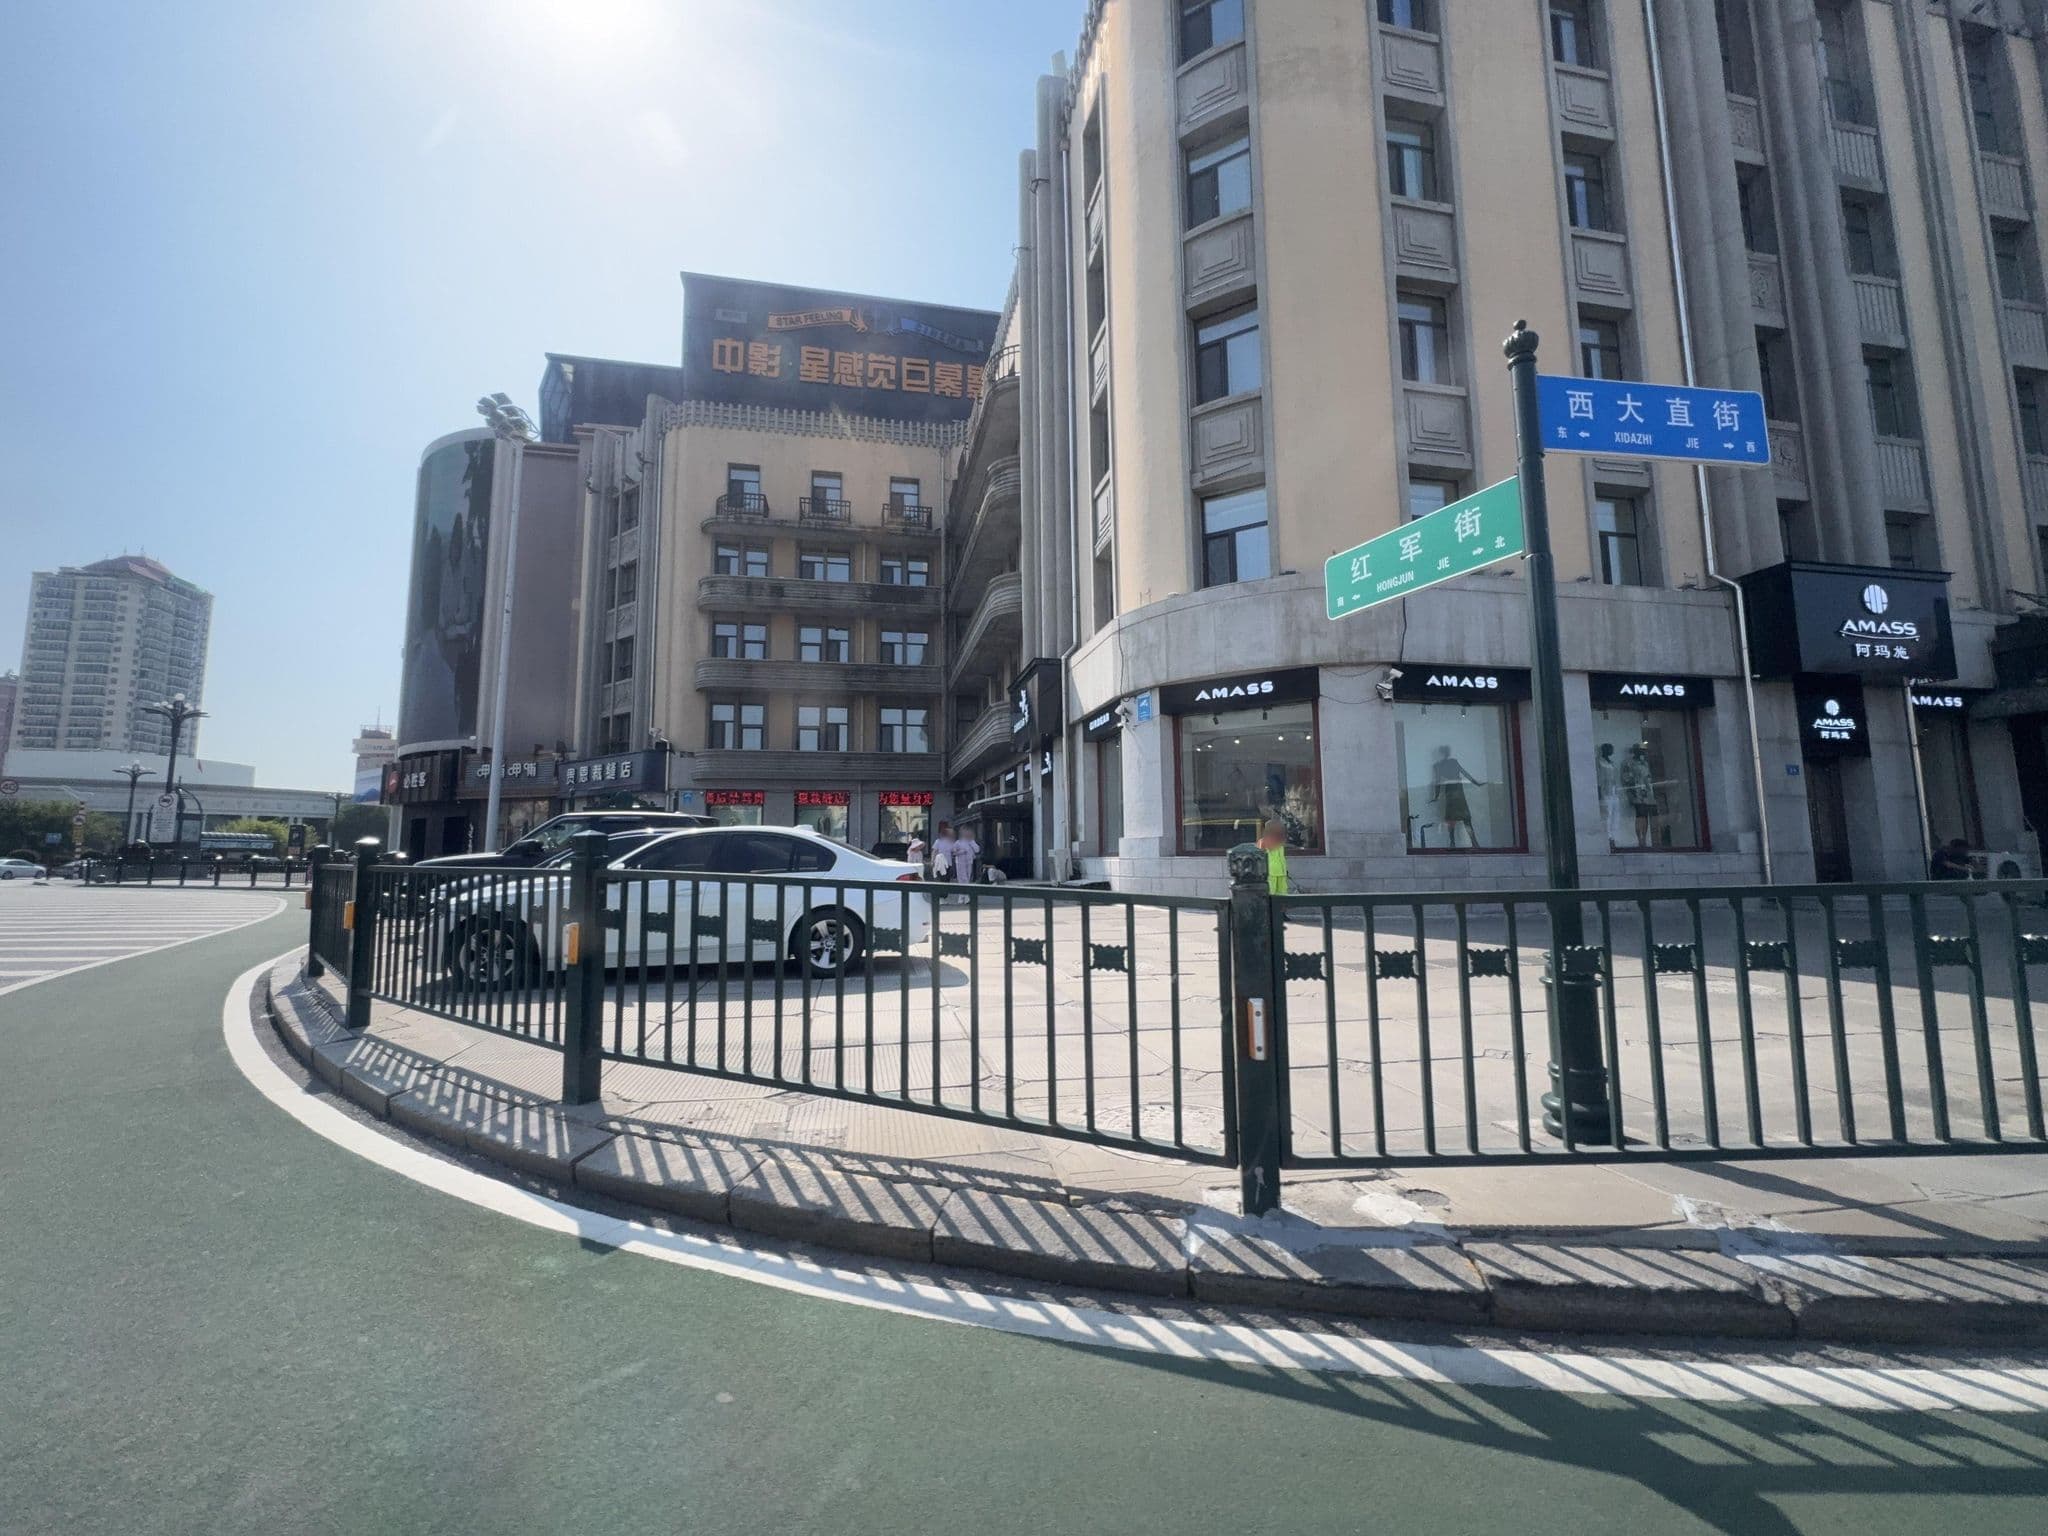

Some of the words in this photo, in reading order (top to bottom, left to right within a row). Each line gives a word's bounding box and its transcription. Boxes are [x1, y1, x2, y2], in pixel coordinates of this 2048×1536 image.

[776, 315, 803, 327] STAR
[803, 311, 843, 324] FEELING
[712, 338, 782, 378] 中影
[1566, 390, 1740, 432] 西大直街
[1557, 426, 1568, 439] 东
[1614, 431, 1652, 446] XIDAZHI
[1685, 437, 1700, 449] JIE
[1746, 441, 1756, 453] 西
[1351, 507, 1482, 584] 红军街
[1376, 570, 1415, 593] HONGJUN
[1437, 556, 1450, 571] JIE
[1495, 535, 1506, 549] 北
[1842, 619, 1918, 636] AMASS
[1855, 643, 1910, 660] 阿玛施
[1426, 674, 1498, 689] AMASS
[1619, 683, 1685, 697] AMASS
[1194, 680, 1274, 702] AMASS
[1814, 718, 1855, 727] AMASS
[477, 762, 537, 779] 呷呷哺
